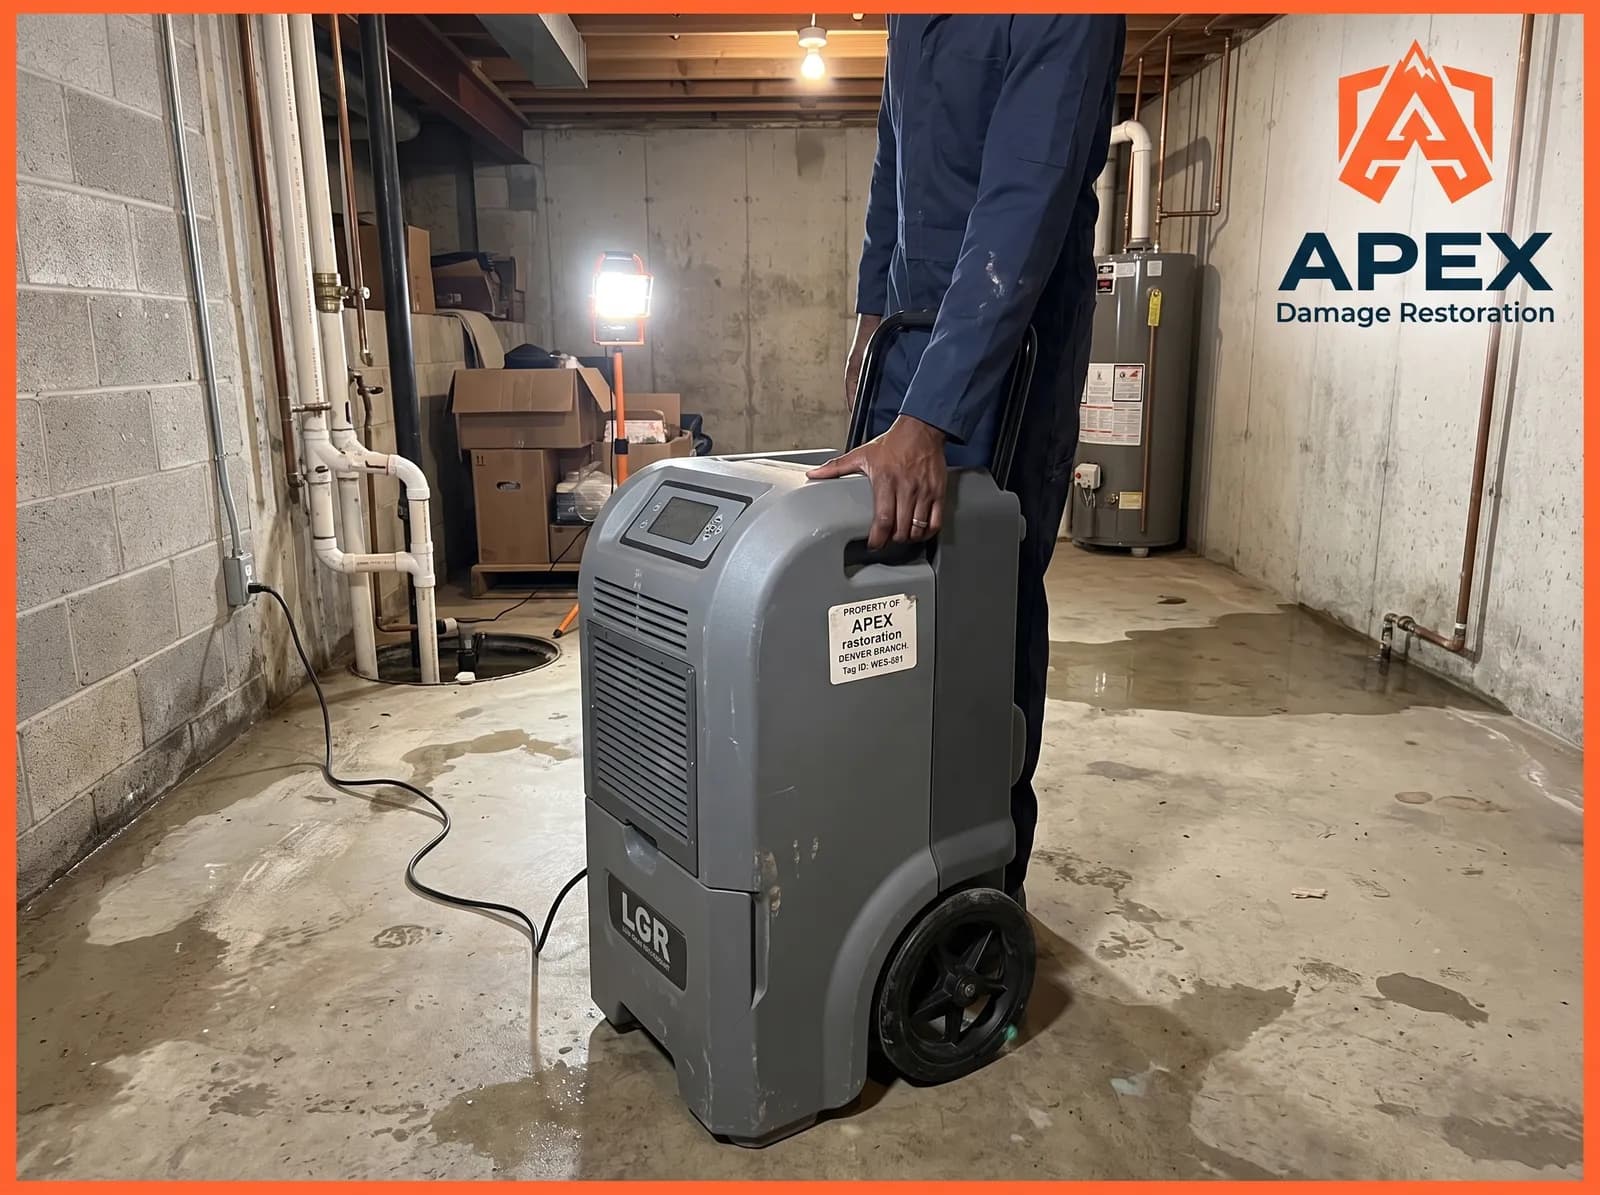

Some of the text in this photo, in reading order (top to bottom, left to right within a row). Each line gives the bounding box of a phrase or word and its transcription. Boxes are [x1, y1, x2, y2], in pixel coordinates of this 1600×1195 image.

[843, 599, 901, 617] PROPERTY OF
[851, 612, 894, 634] APEX
[842, 630, 902, 650] rastoration
[838, 649, 872, 663] DENVER
[843, 666, 857, 675] Tag
[858, 663, 869, 672] ID:
[622, 891, 671, 964] LGR
